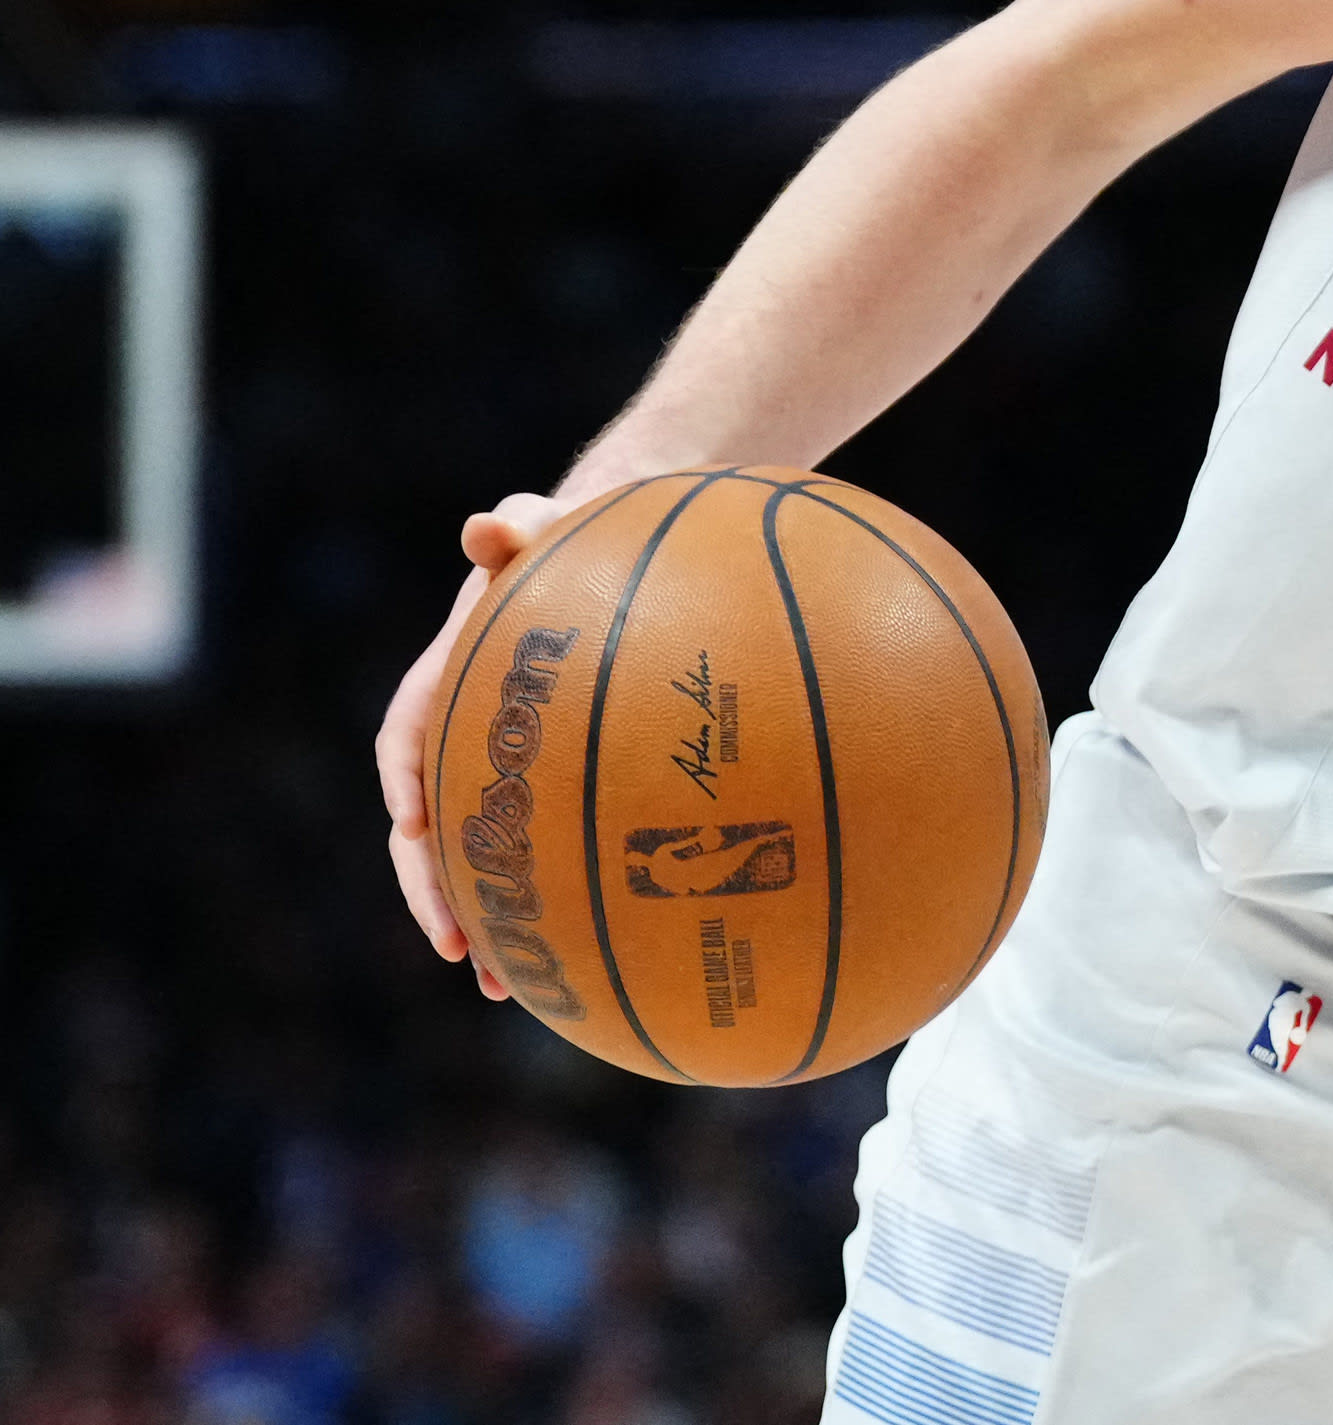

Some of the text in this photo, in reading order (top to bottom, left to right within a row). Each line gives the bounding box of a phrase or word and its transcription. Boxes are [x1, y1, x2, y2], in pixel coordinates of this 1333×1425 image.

[719, 682, 739, 764] COMMISSIONER
[461, 626, 587, 1022] Wilson
[699, 917, 726, 949] BALL
[702, 949, 729, 983] GAME
[1250, 1043, 1277, 1066] NBA
